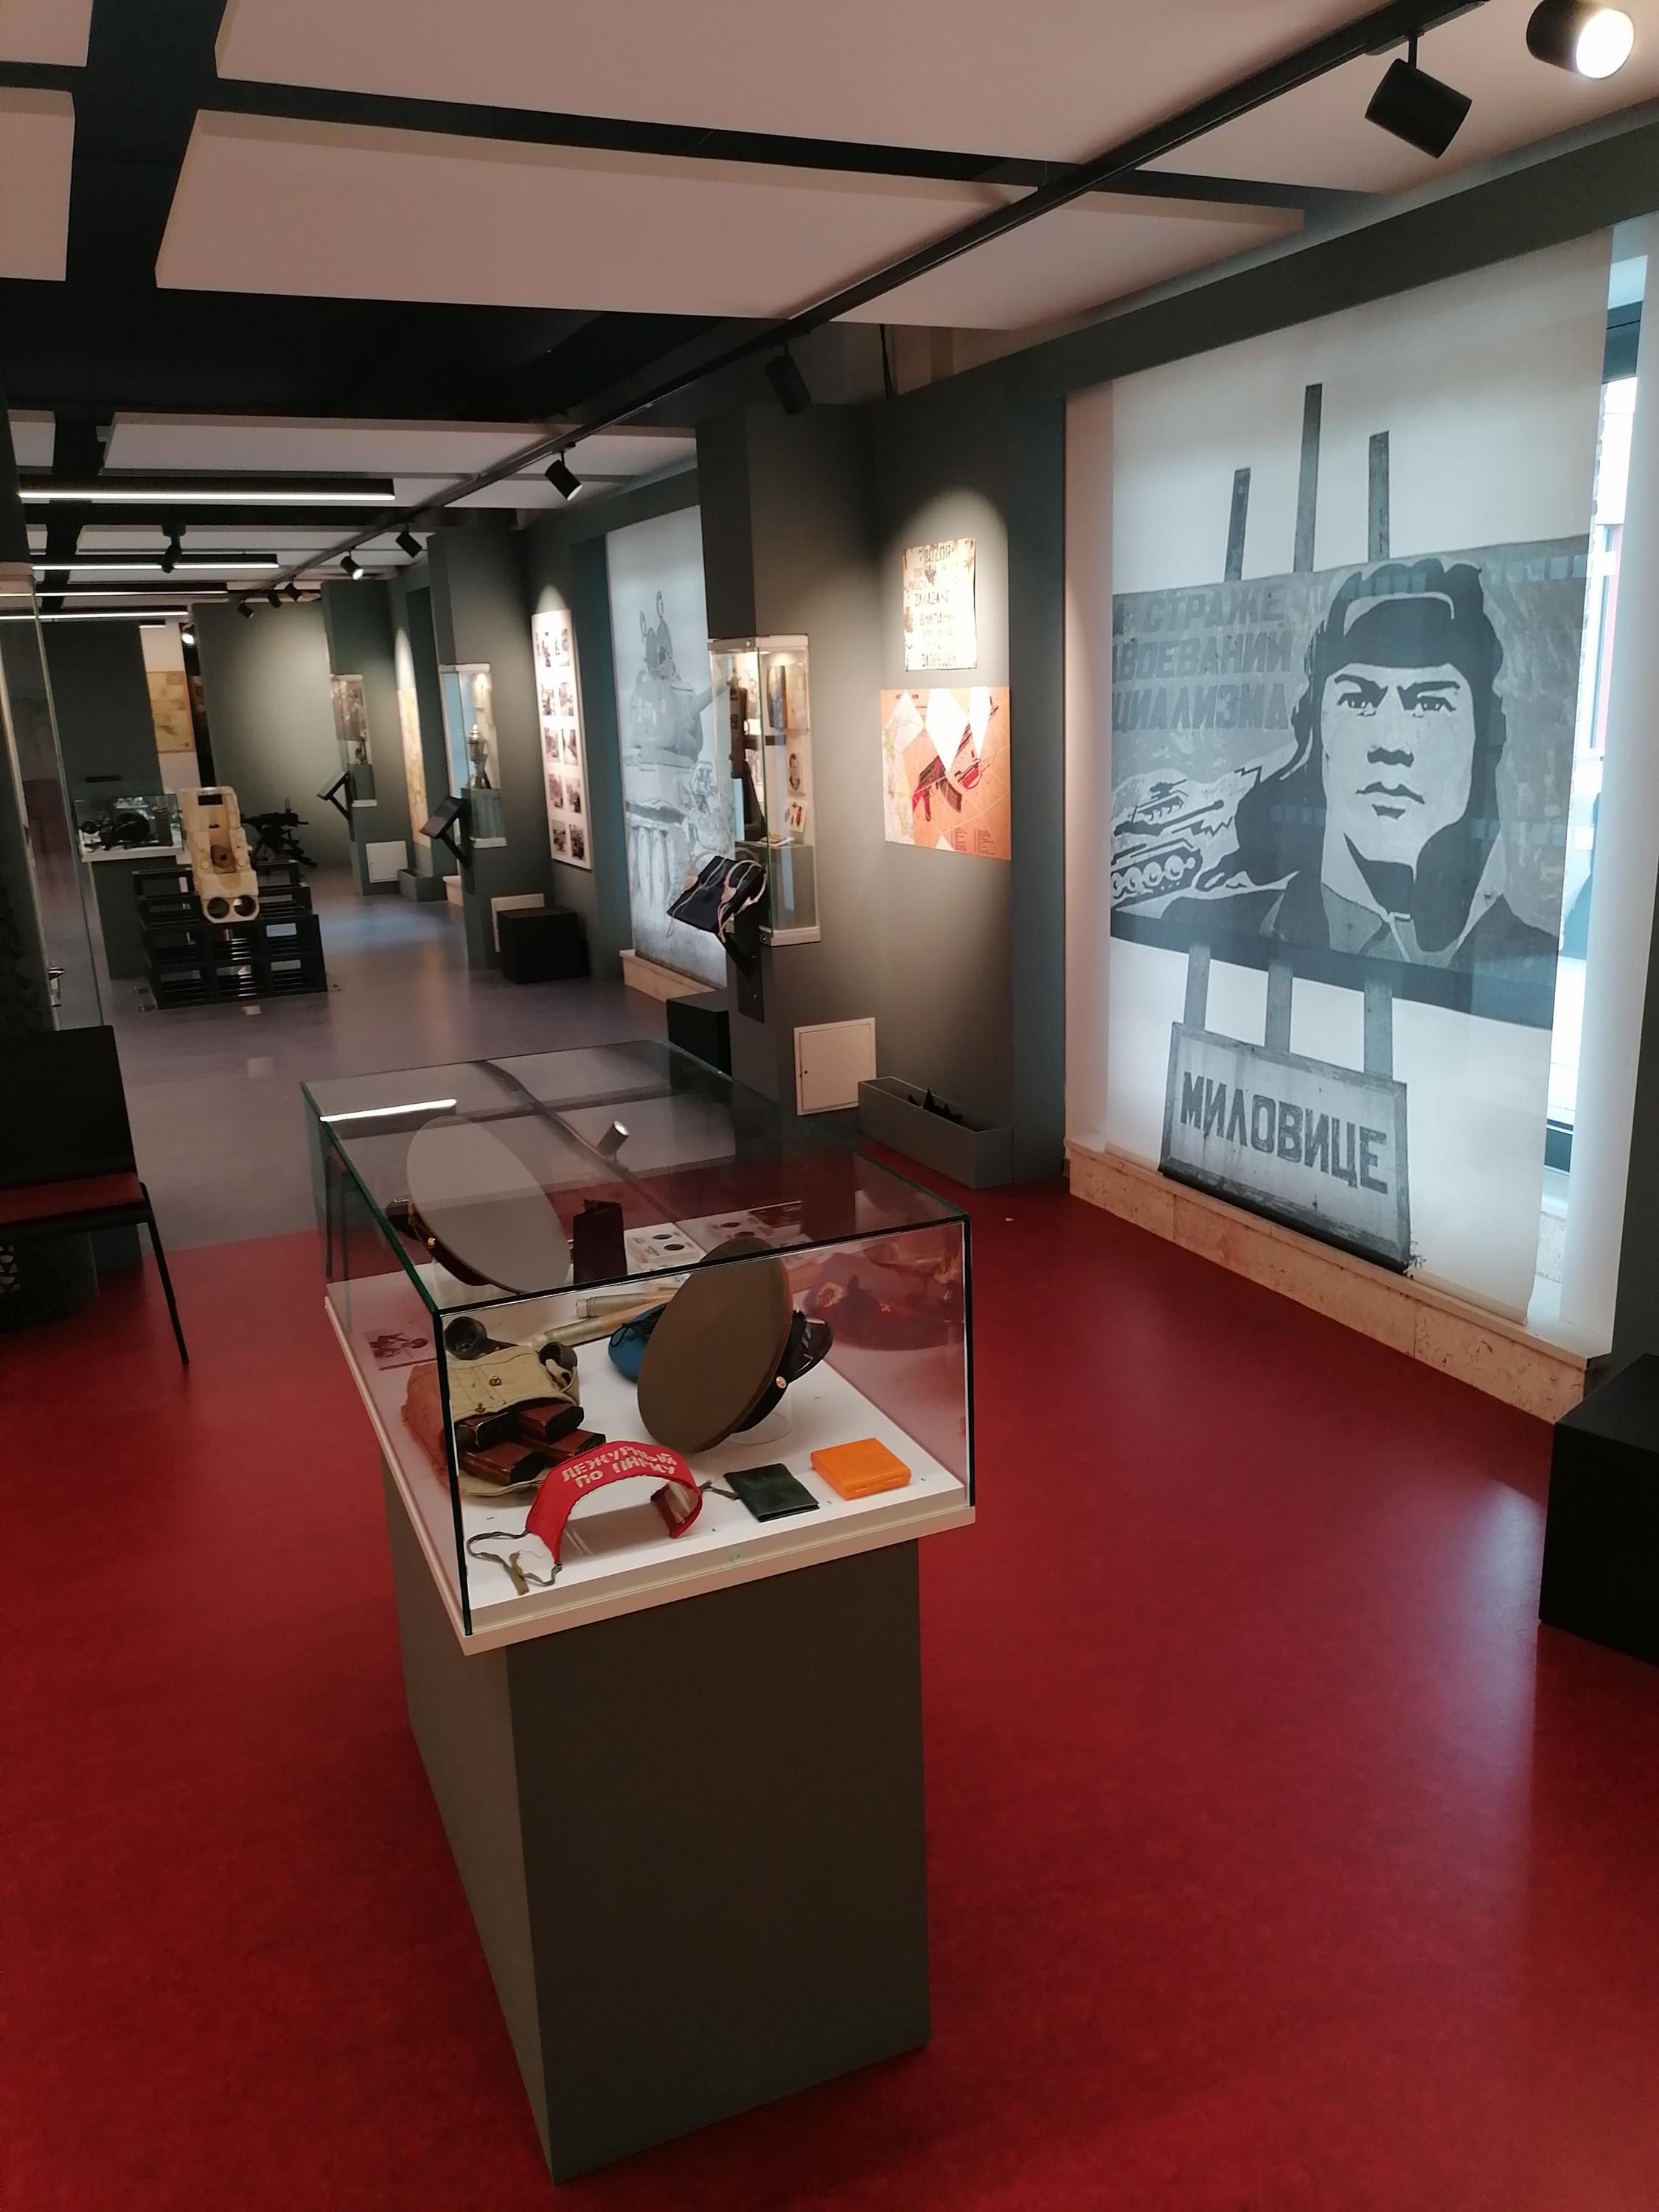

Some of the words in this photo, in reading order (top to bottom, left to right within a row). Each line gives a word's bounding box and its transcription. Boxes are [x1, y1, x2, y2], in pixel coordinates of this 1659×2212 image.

[1113, 625, 1292, 684] ВОЕВАНИЙ
[1180, 1071, 1388, 1194] МИЛОВИЦЕ
[561, 1445, 677, 1482] ДЕЖУРНЫЙ
[574, 1470, 603, 1488] ПО
